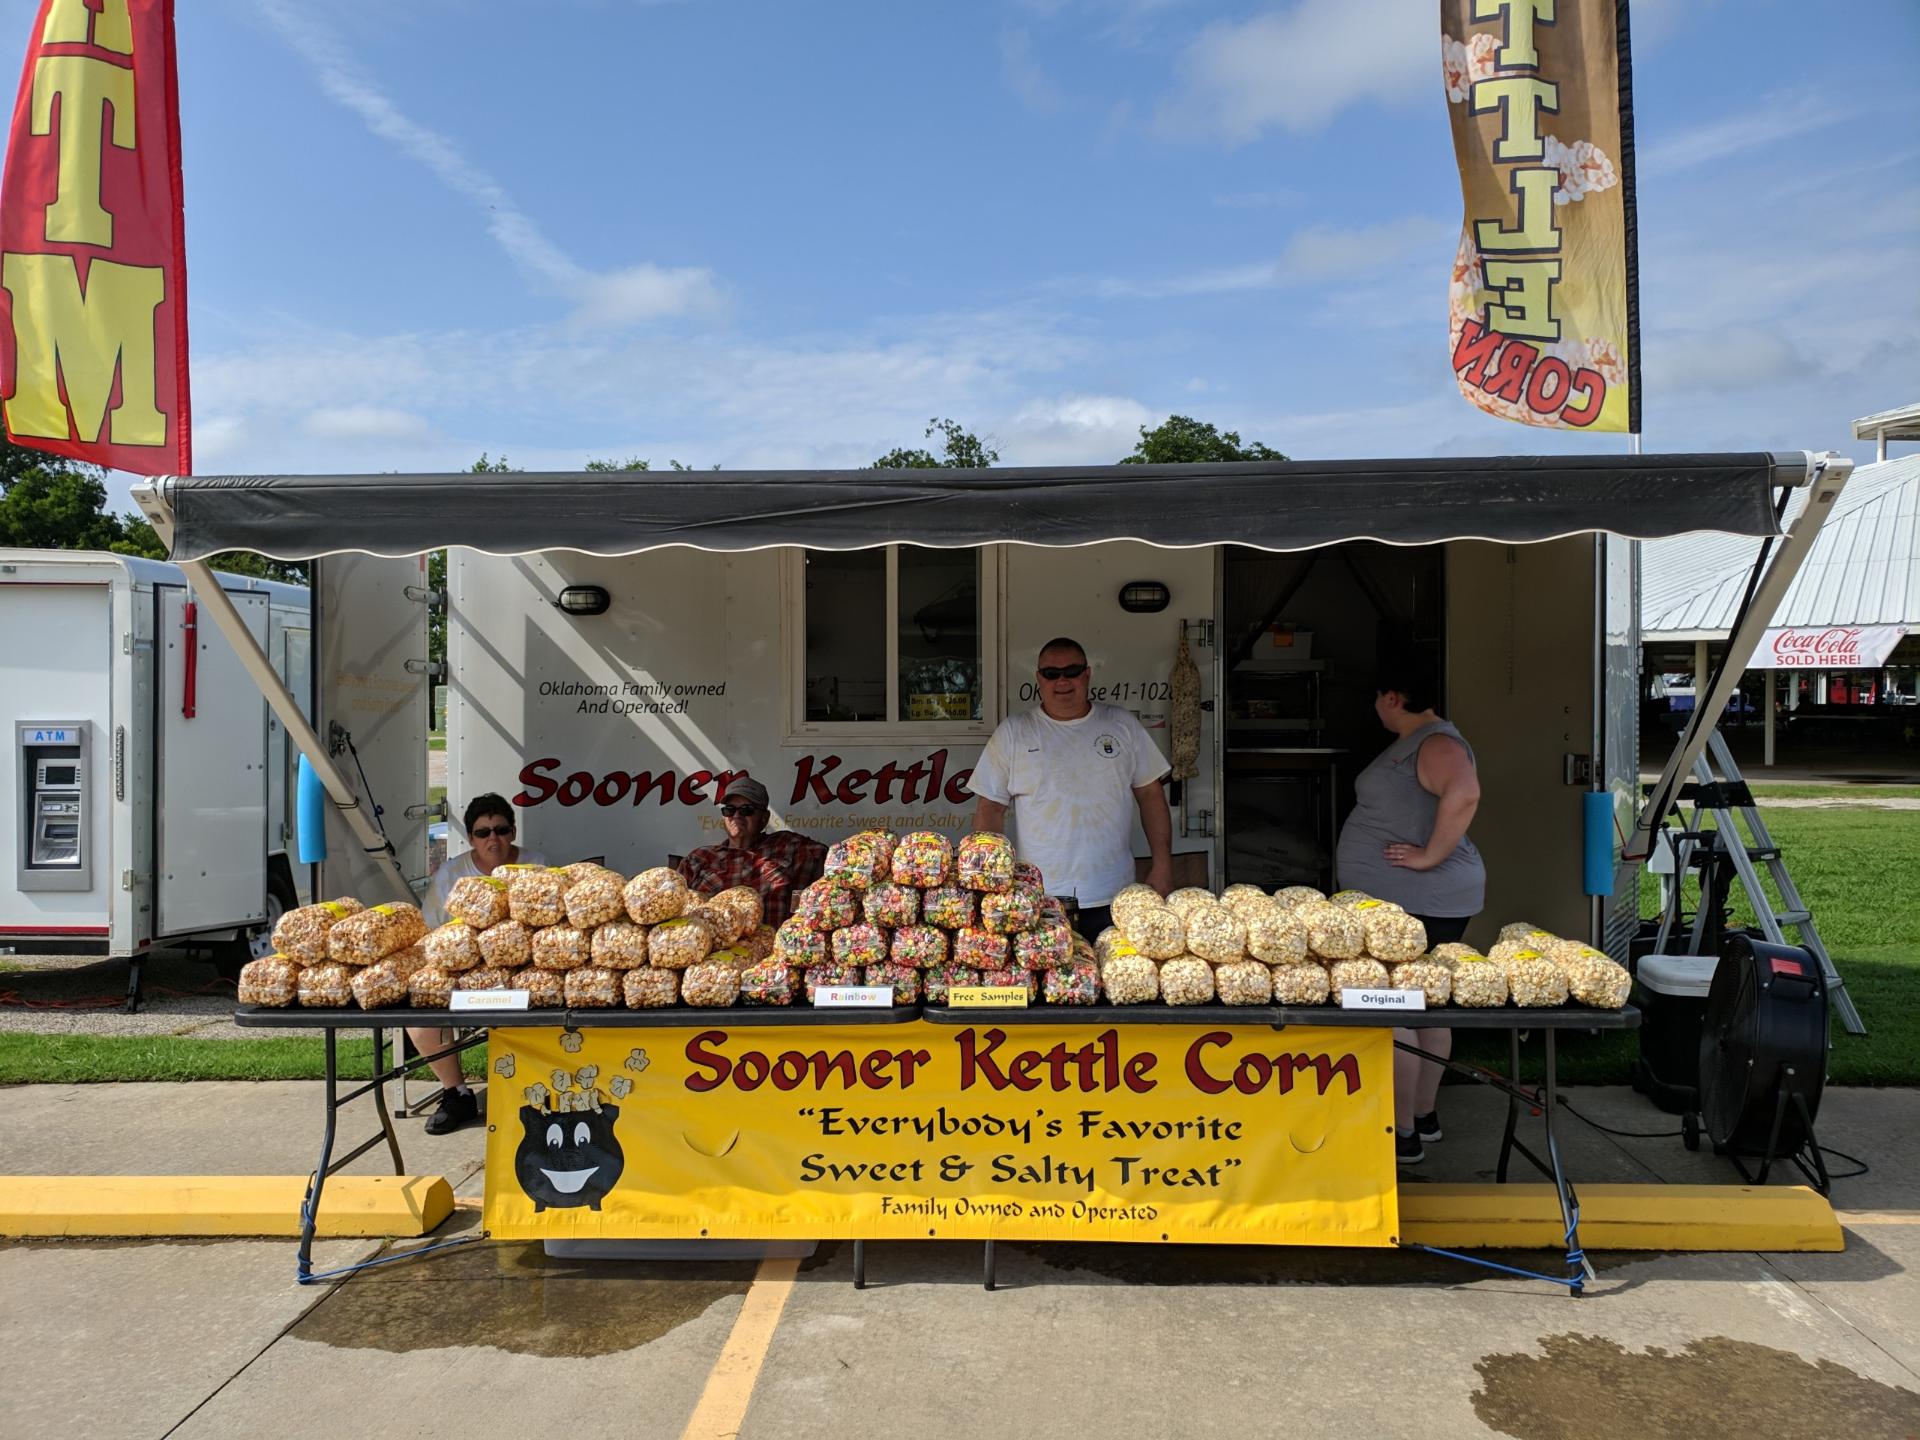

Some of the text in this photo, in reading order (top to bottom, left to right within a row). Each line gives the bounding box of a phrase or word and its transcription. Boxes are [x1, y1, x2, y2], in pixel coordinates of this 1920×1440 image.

[2, 0, 167, 447] TM
[1776, 654, 1861, 666] SOLD HERE!
[539, 681, 726, 698] Oklahoma Family owned
[577, 700, 689, 717] And Operated!
[35, 731, 65, 741] ATM
[512, 748, 976, 807] Sooner Kettle
[784, 814, 845, 829] Favorite
[849, 813, 894, 829] Sweet
[898, 812, 925, 828] and
[928, 812, 966, 831] Salty
[468, 996, 512, 1004] Caramel
[953, 991, 1024, 1003] Free Samples
[1361, 994, 1406, 1005] Original
[685, 1028, 1362, 1096] Sooner Kettle Corn
[1077, 1110, 1243, 1141] Favorite
[799, 1153, 925, 1182] Sweet
[939, 1154, 976, 1182] &
[991, 1153, 1095, 1193] Salty
[881, 1196, 1159, 1224] Family Owned and Operated
